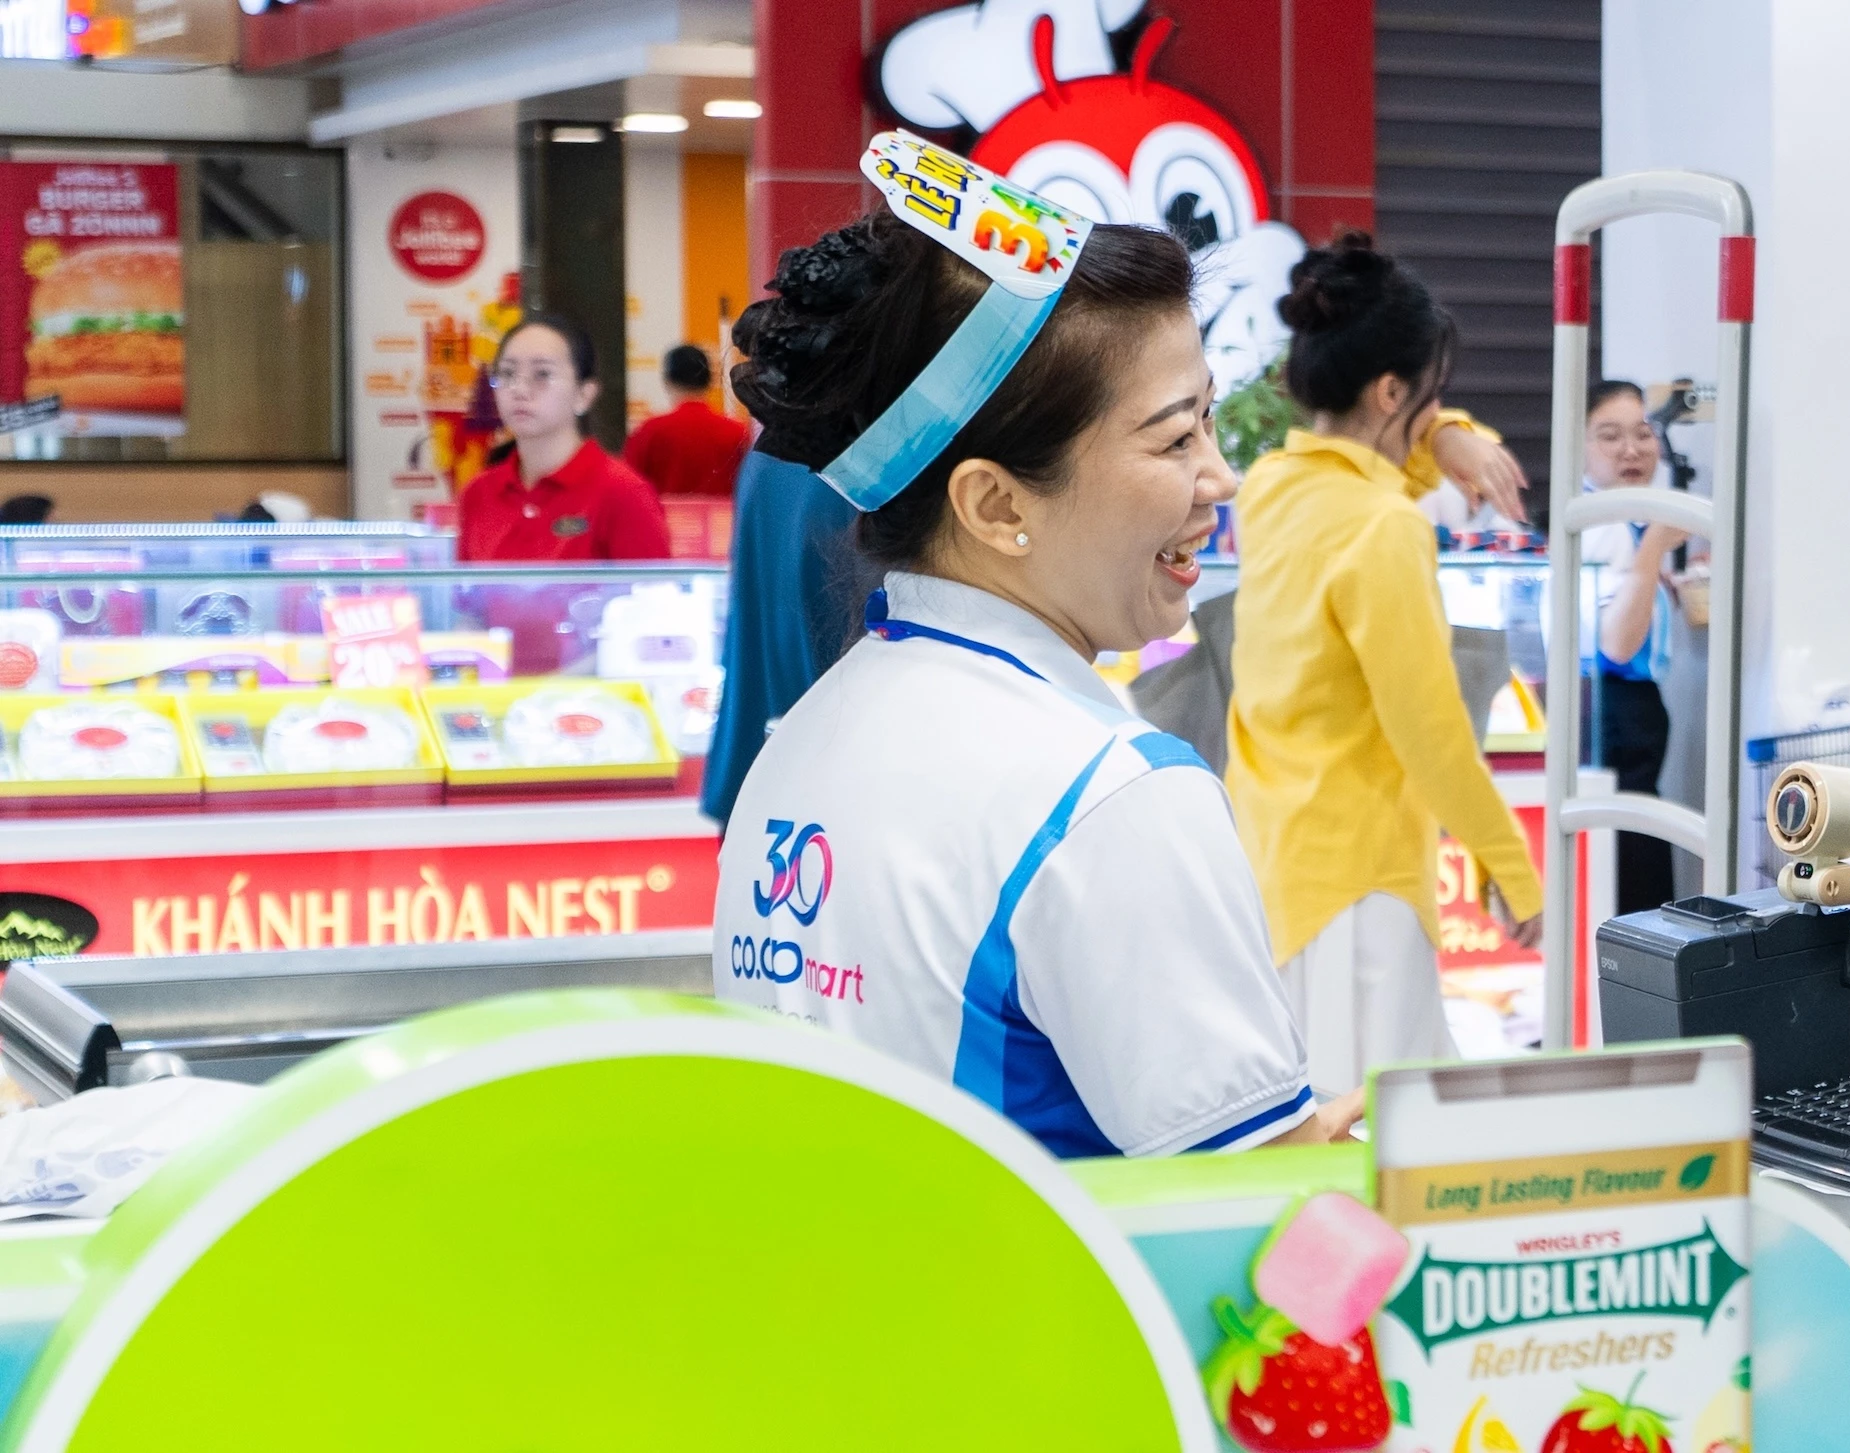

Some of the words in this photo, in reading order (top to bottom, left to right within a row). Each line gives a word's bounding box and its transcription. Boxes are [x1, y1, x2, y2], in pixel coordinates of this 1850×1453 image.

[40, 190, 144, 211] BURGER
[754, 819, 833, 927] 30
[132, 872, 349, 957] KHÁNH
[367, 865, 489, 946] HÒA
[1601, 956, 1619, 972] EPSON
[1425, 1184, 1481, 1212] Long
[1490, 1173, 1573, 1204] Lasting
[1581, 1167, 1666, 1196] Flavour
[1516, 1229, 1622, 1255] WRIGLEY'S
[1422, 1238, 1714, 1337] DOUBLEMINT
[1470, 1331, 1675, 1380] Refreshers
